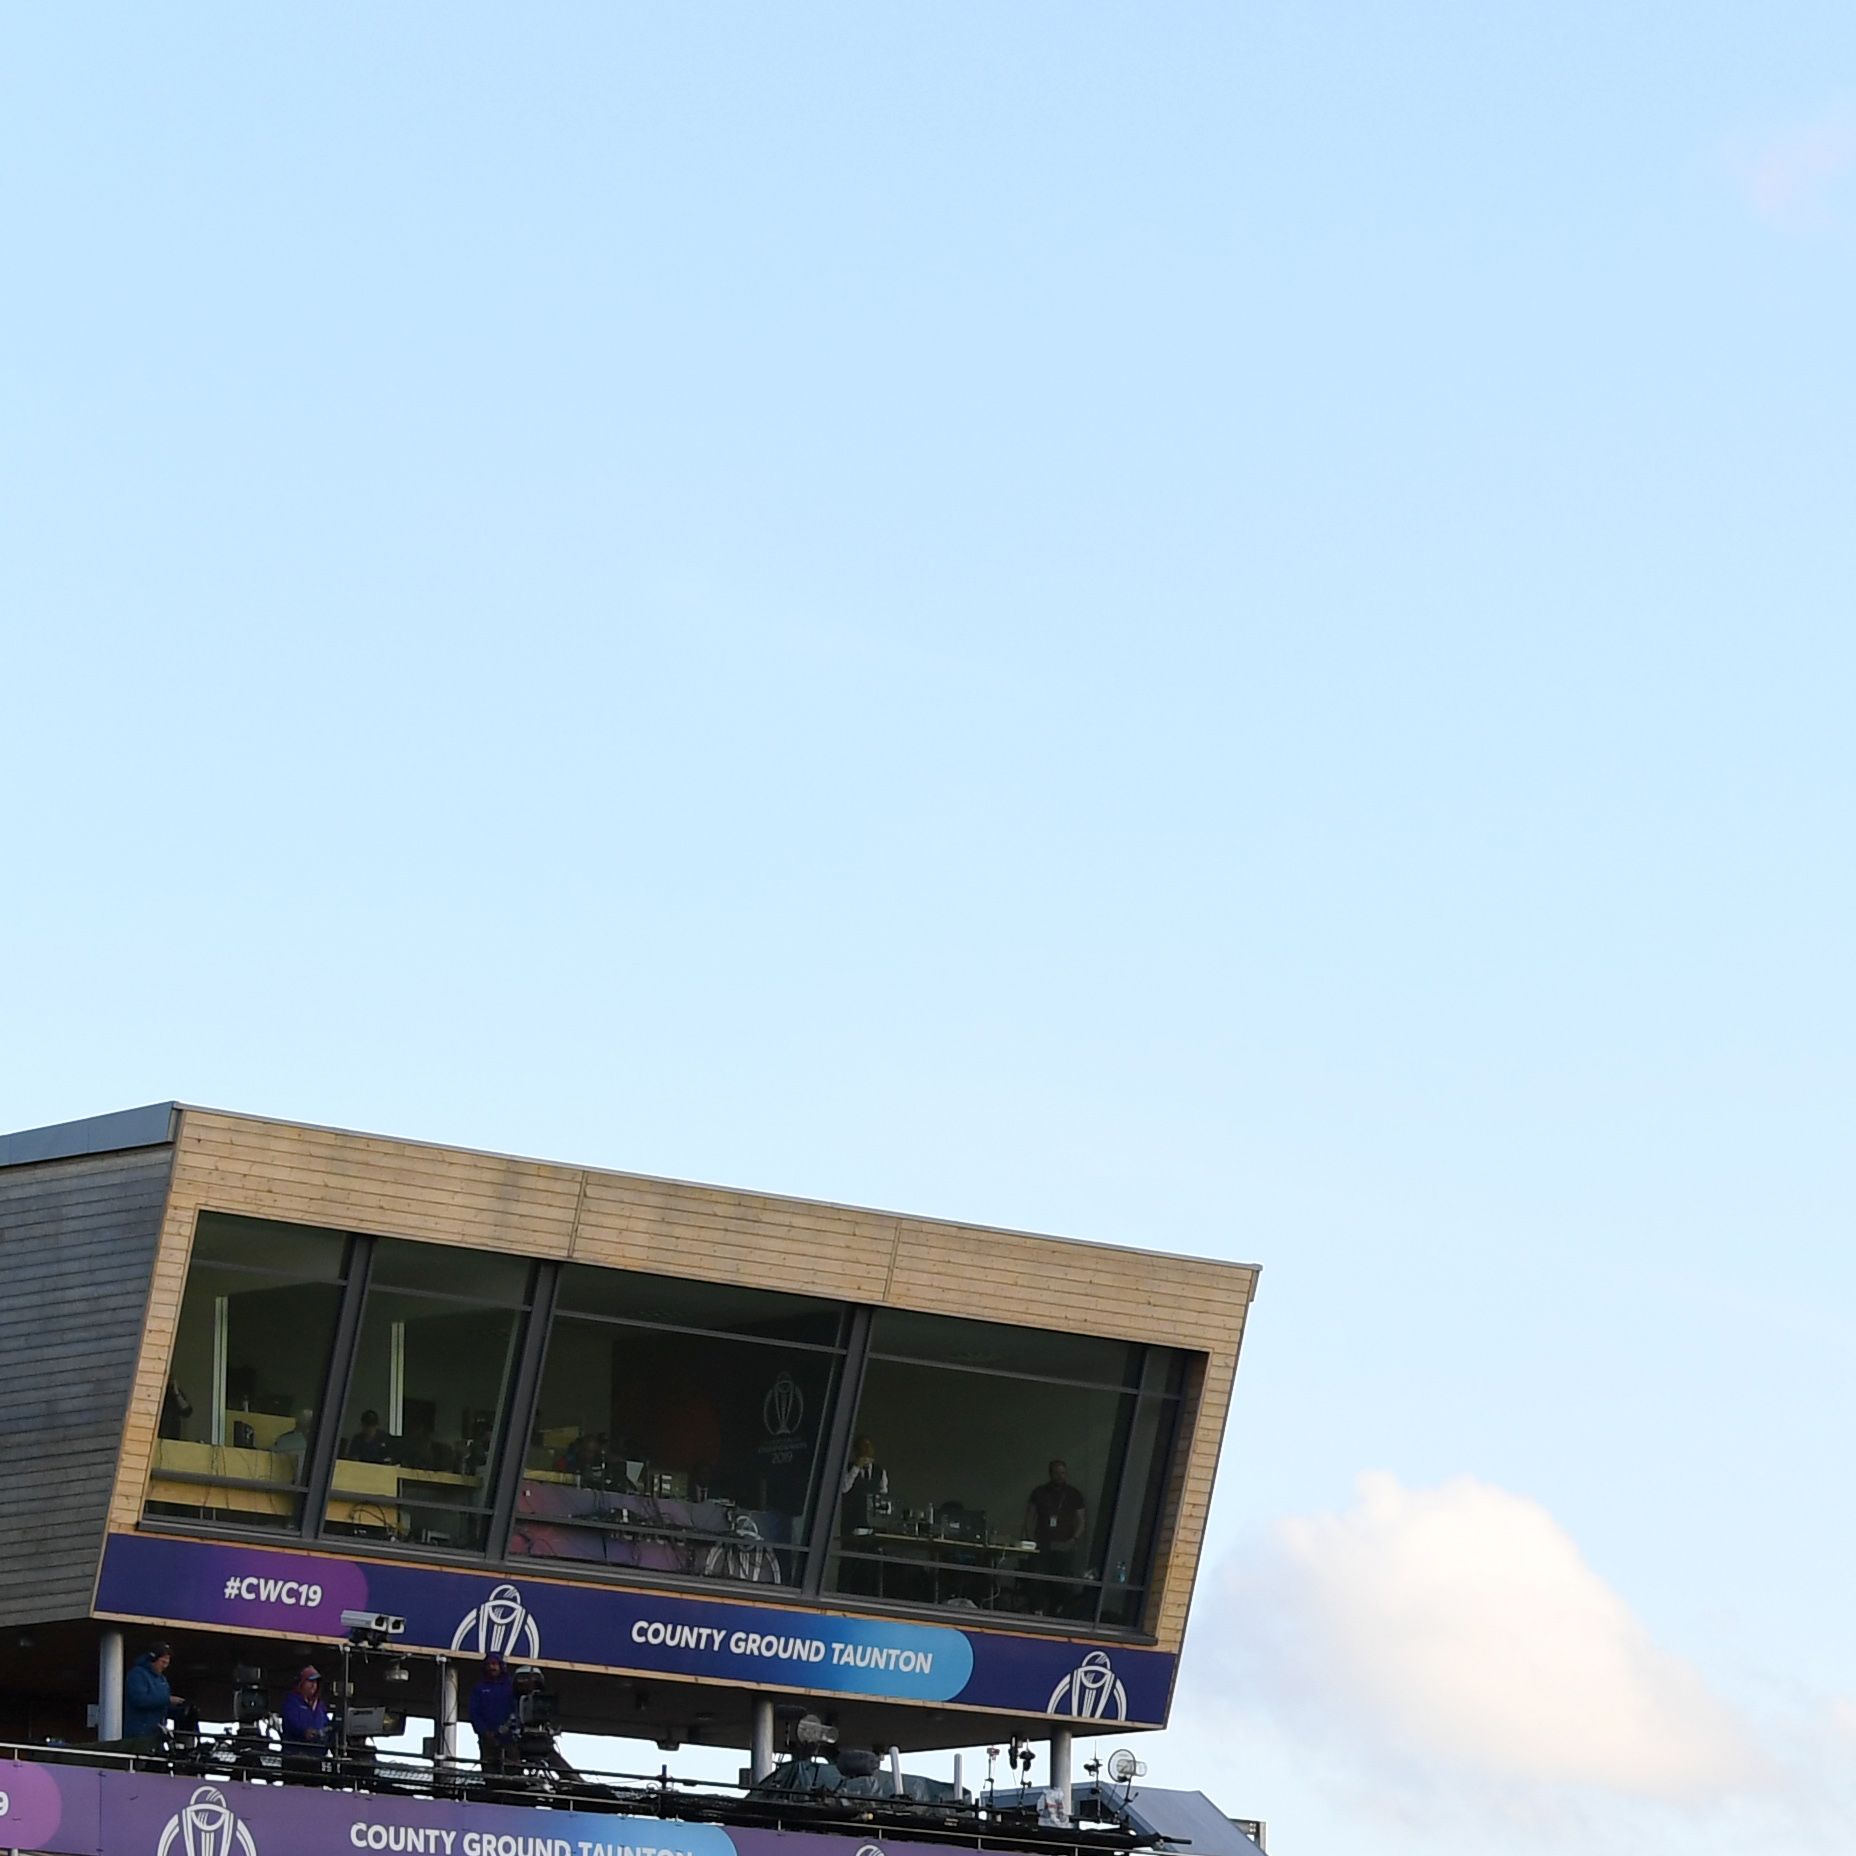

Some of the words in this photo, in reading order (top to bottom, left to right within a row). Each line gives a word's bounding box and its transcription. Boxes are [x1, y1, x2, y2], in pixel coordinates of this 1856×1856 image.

[224, 1576, 322, 1607] #CWC19
[631, 1620, 727, 1652] COUNTY
[729, 1631, 826, 1663] GROUND
[831, 1642, 933, 1675] TAUNTON
[350, 1822, 457, 1855] COUNTY
